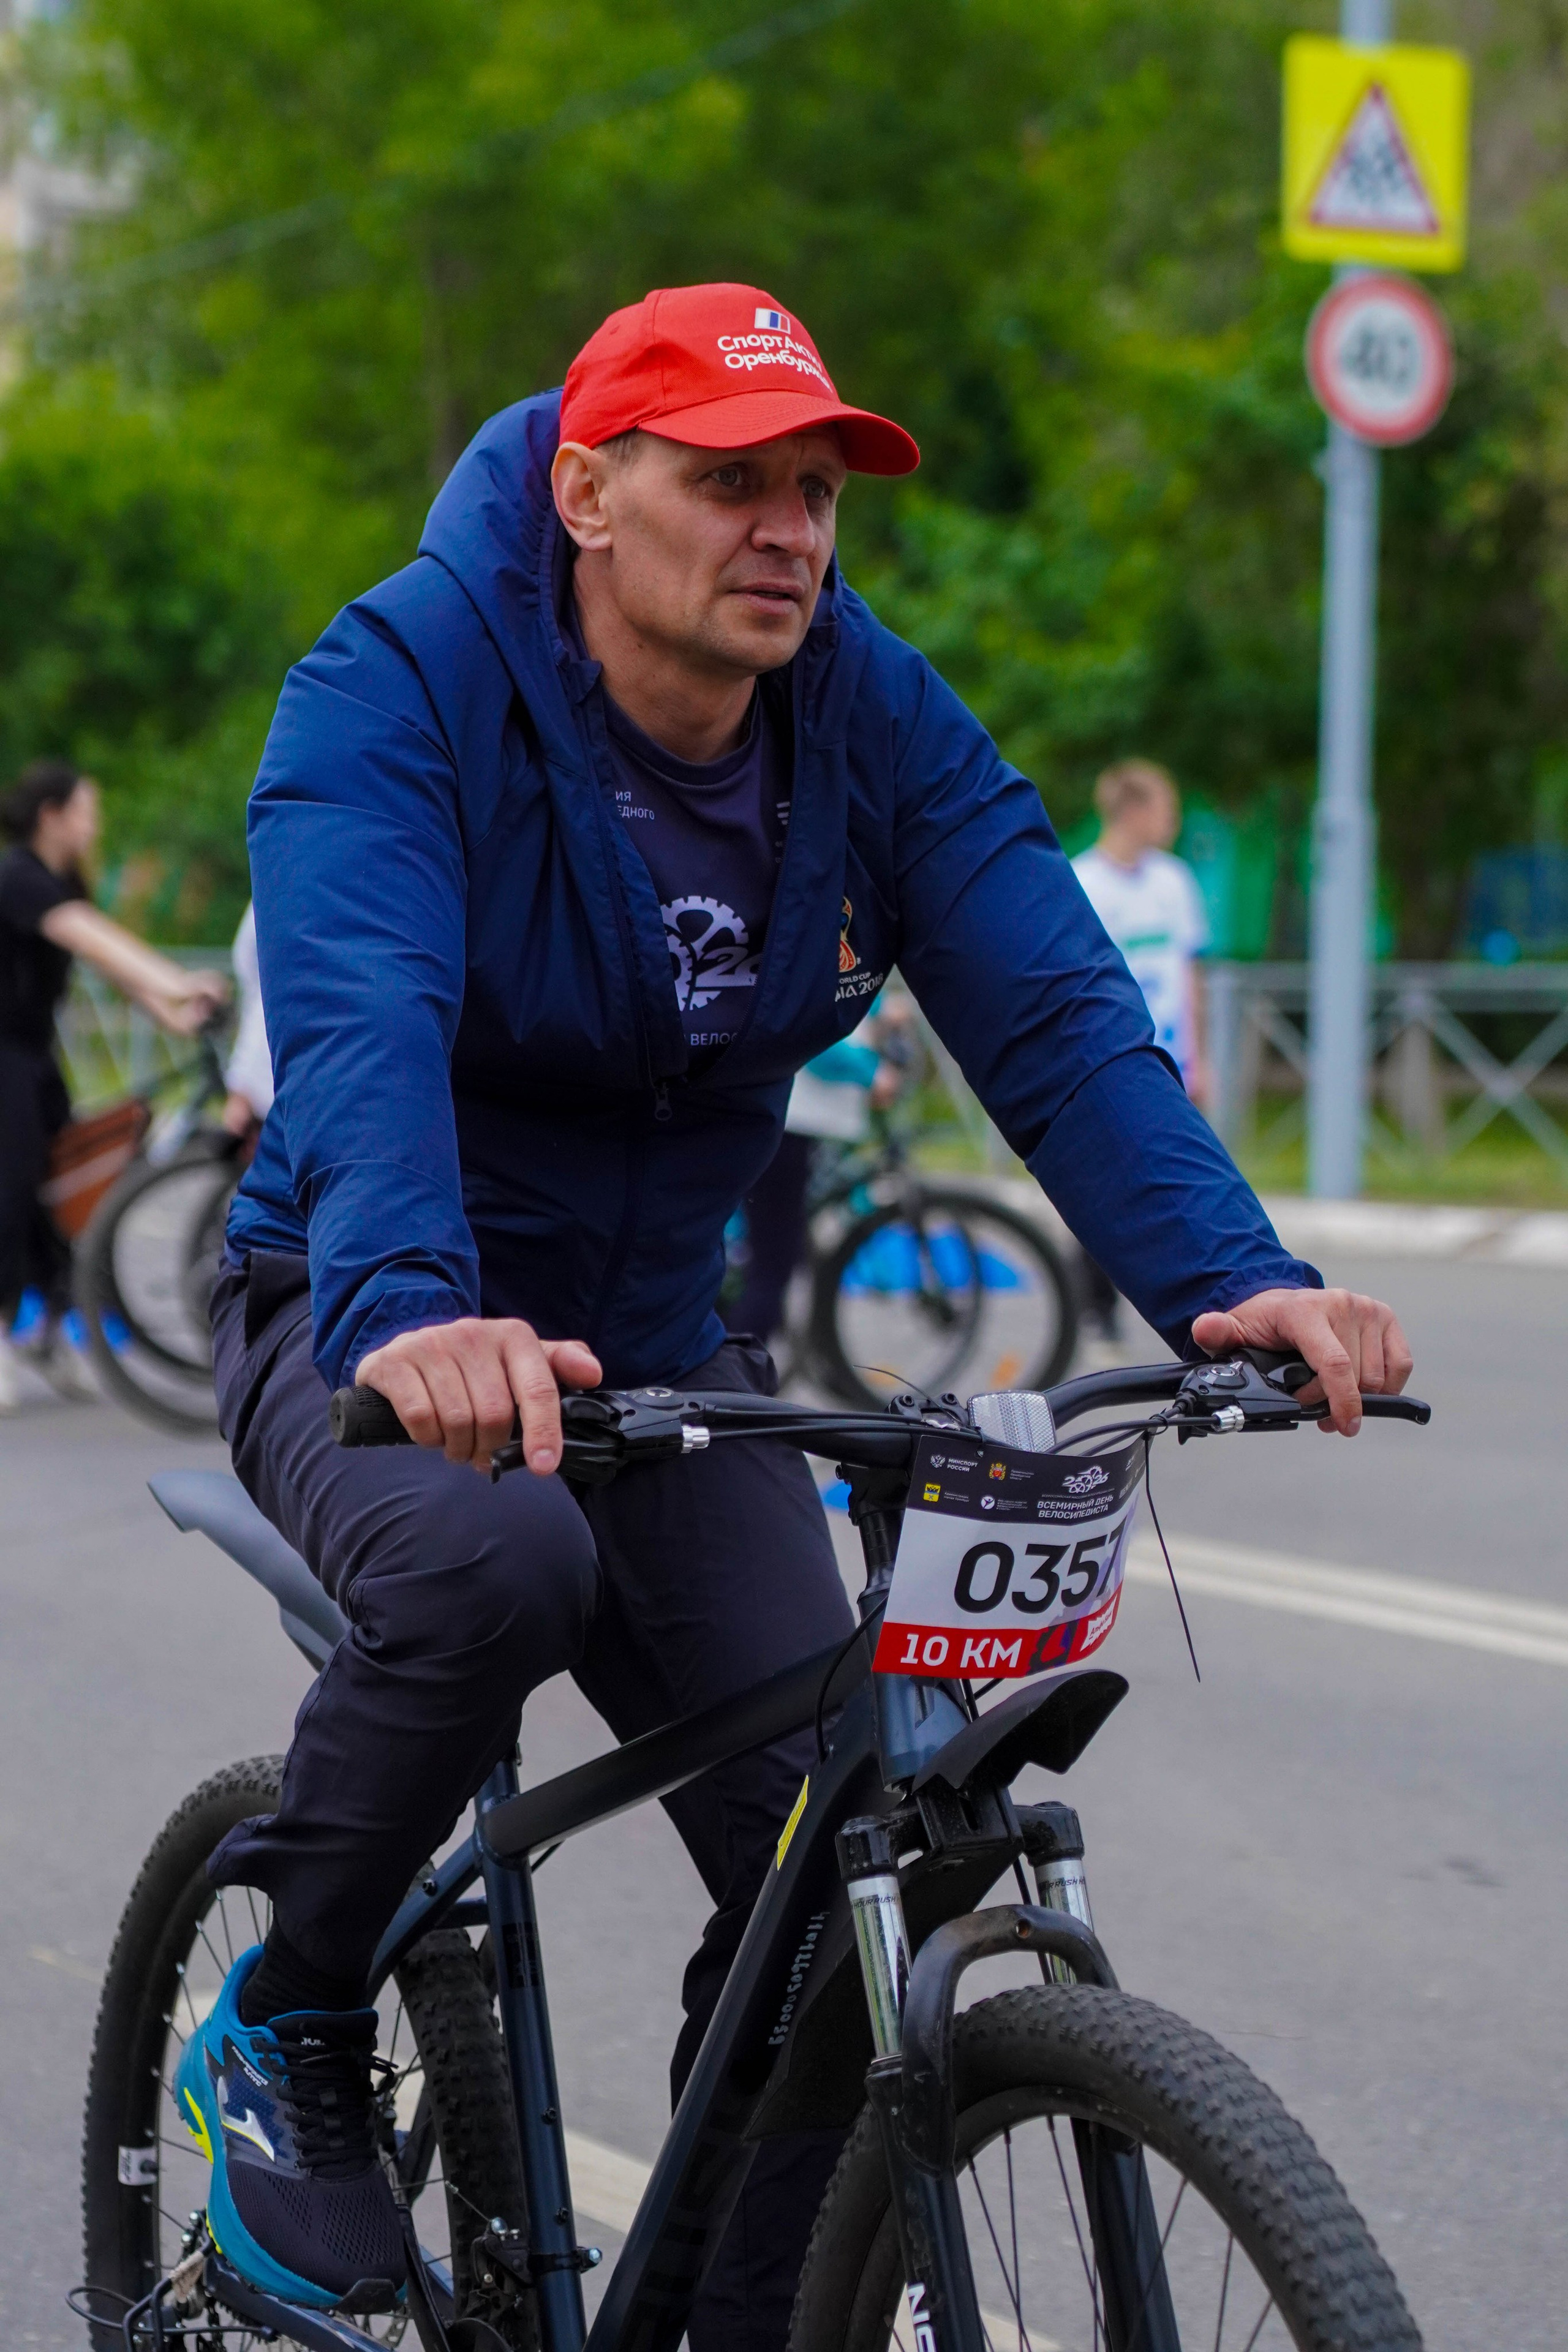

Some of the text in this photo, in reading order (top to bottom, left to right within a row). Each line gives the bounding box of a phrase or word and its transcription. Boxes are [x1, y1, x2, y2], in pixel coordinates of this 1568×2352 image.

[859, 971, 872, 980] CUP
[946, 1463, 970, 1472] РОССИИ
[948, 1458, 978, 1468] МИНСПОРТ
[1037, 1498, 1094, 1510] ВСЕМИРНЫЙ
[1094, 1493, 1114, 1506] ДЕНЬ
[1038, 1504, 1109, 1520] ВЕЛОСИПЕДИСТА
[954, 1515, 1127, 1614] 0357
[900, 1633, 949, 1667] 10
